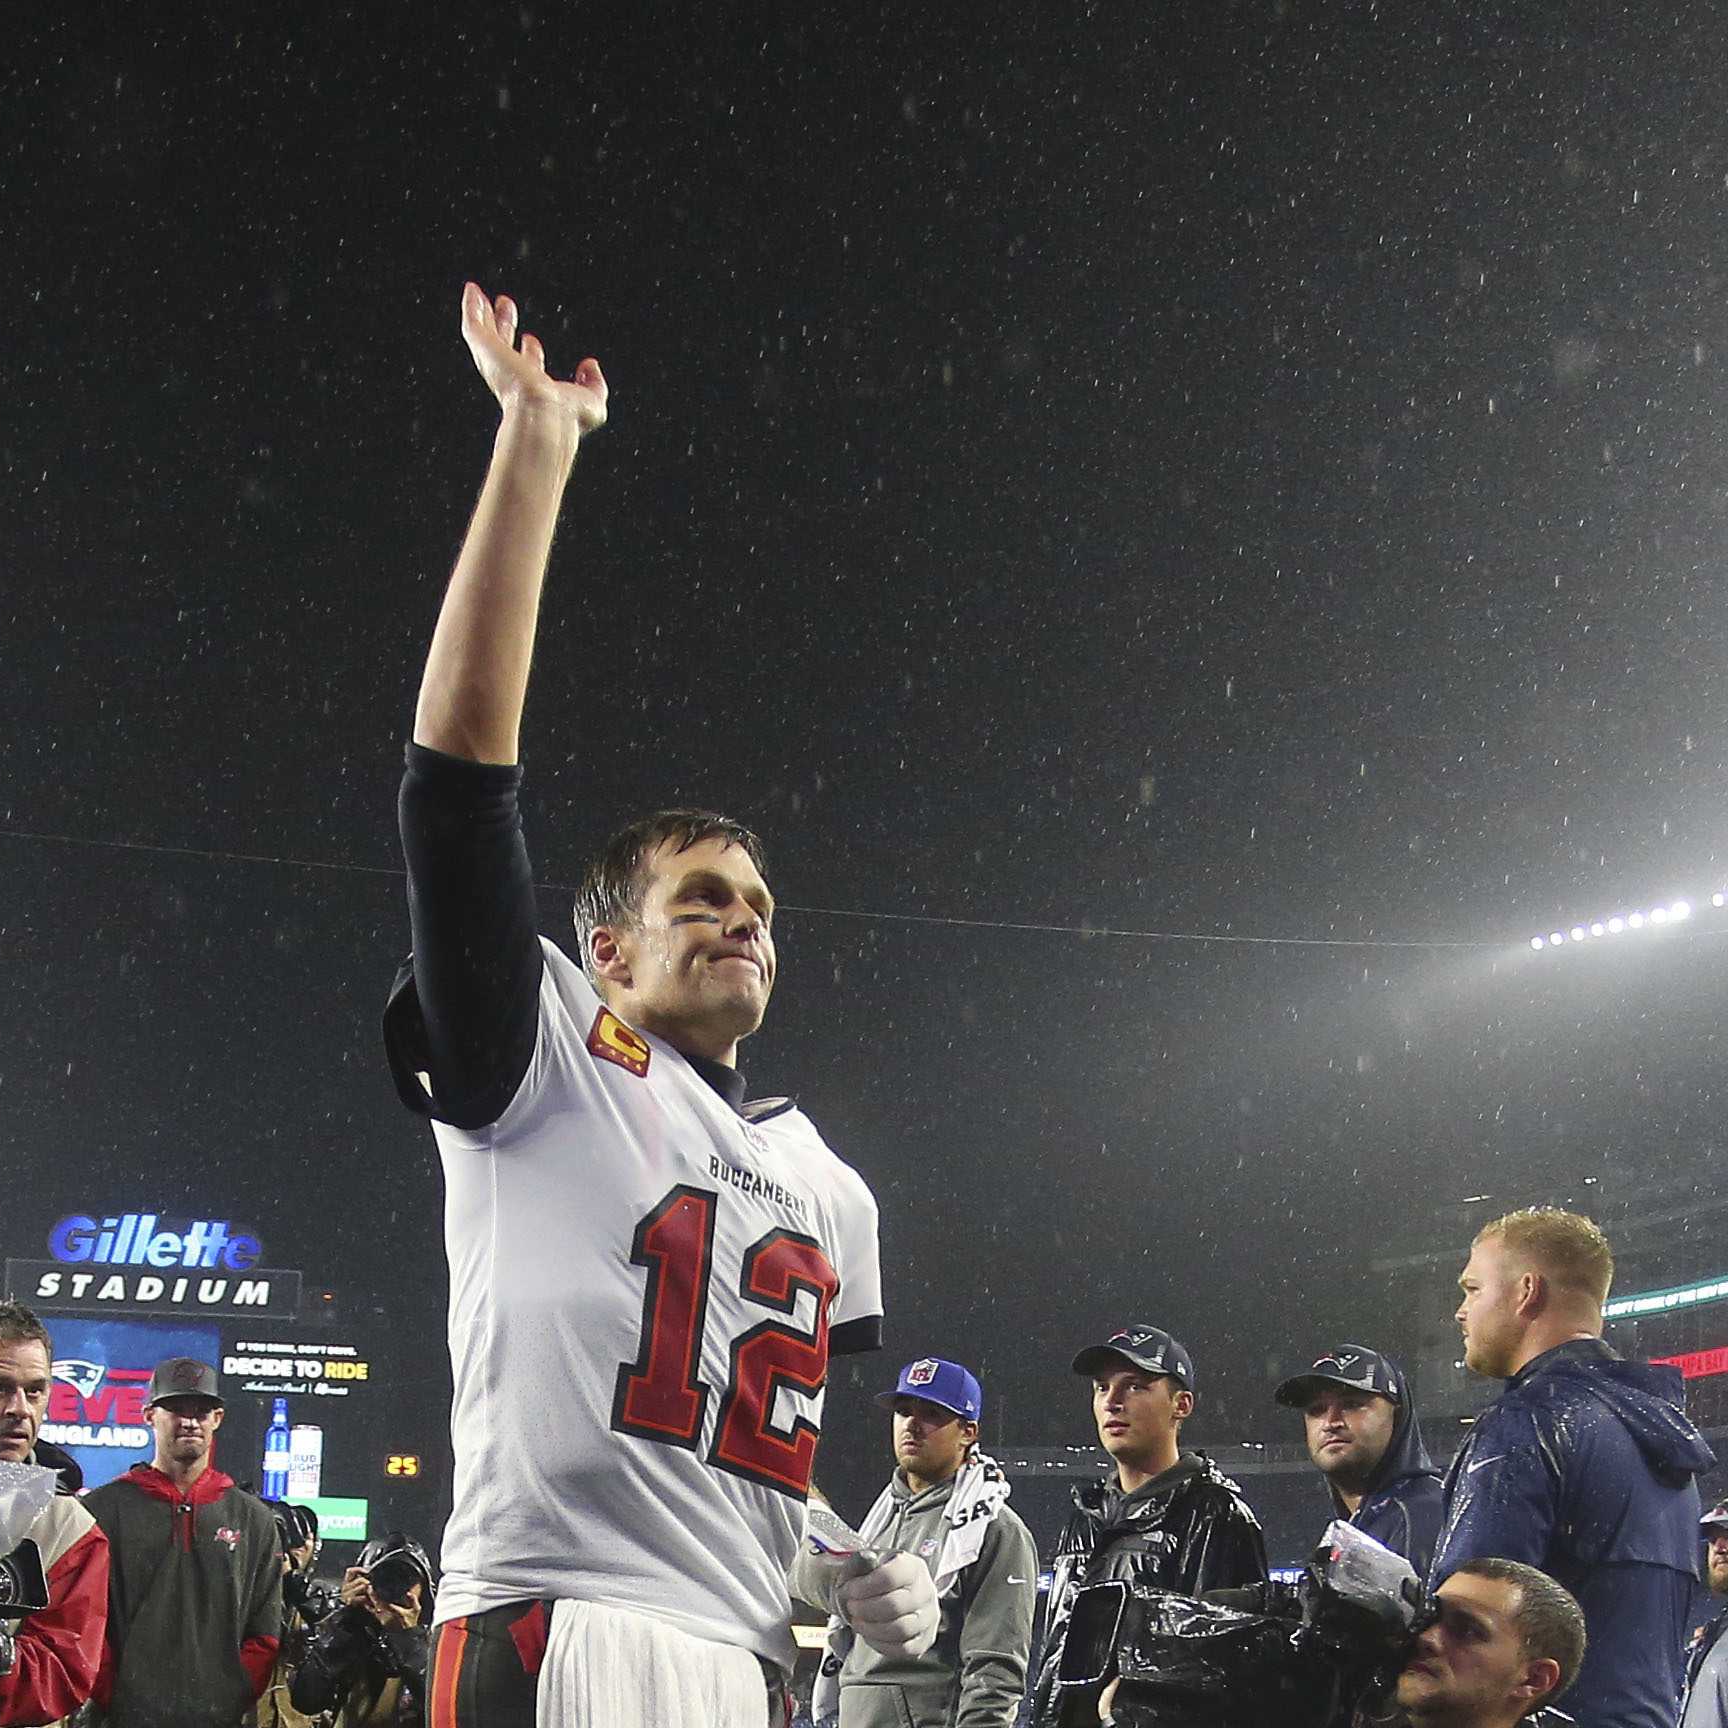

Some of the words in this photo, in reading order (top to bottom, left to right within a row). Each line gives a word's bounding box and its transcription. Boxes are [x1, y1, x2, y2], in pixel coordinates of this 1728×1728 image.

[48, 1214, 263, 1271] Gillette
[36, 1272, 270, 1306] STADIUM
[611, 1183, 840, 1503] 12
[223, 1356, 293, 1377] DECIDE
[294, 1360, 323, 1379] TO
[324, 1361, 369, 1381] RIDE
[386, 1456, 418, 1477] 25
